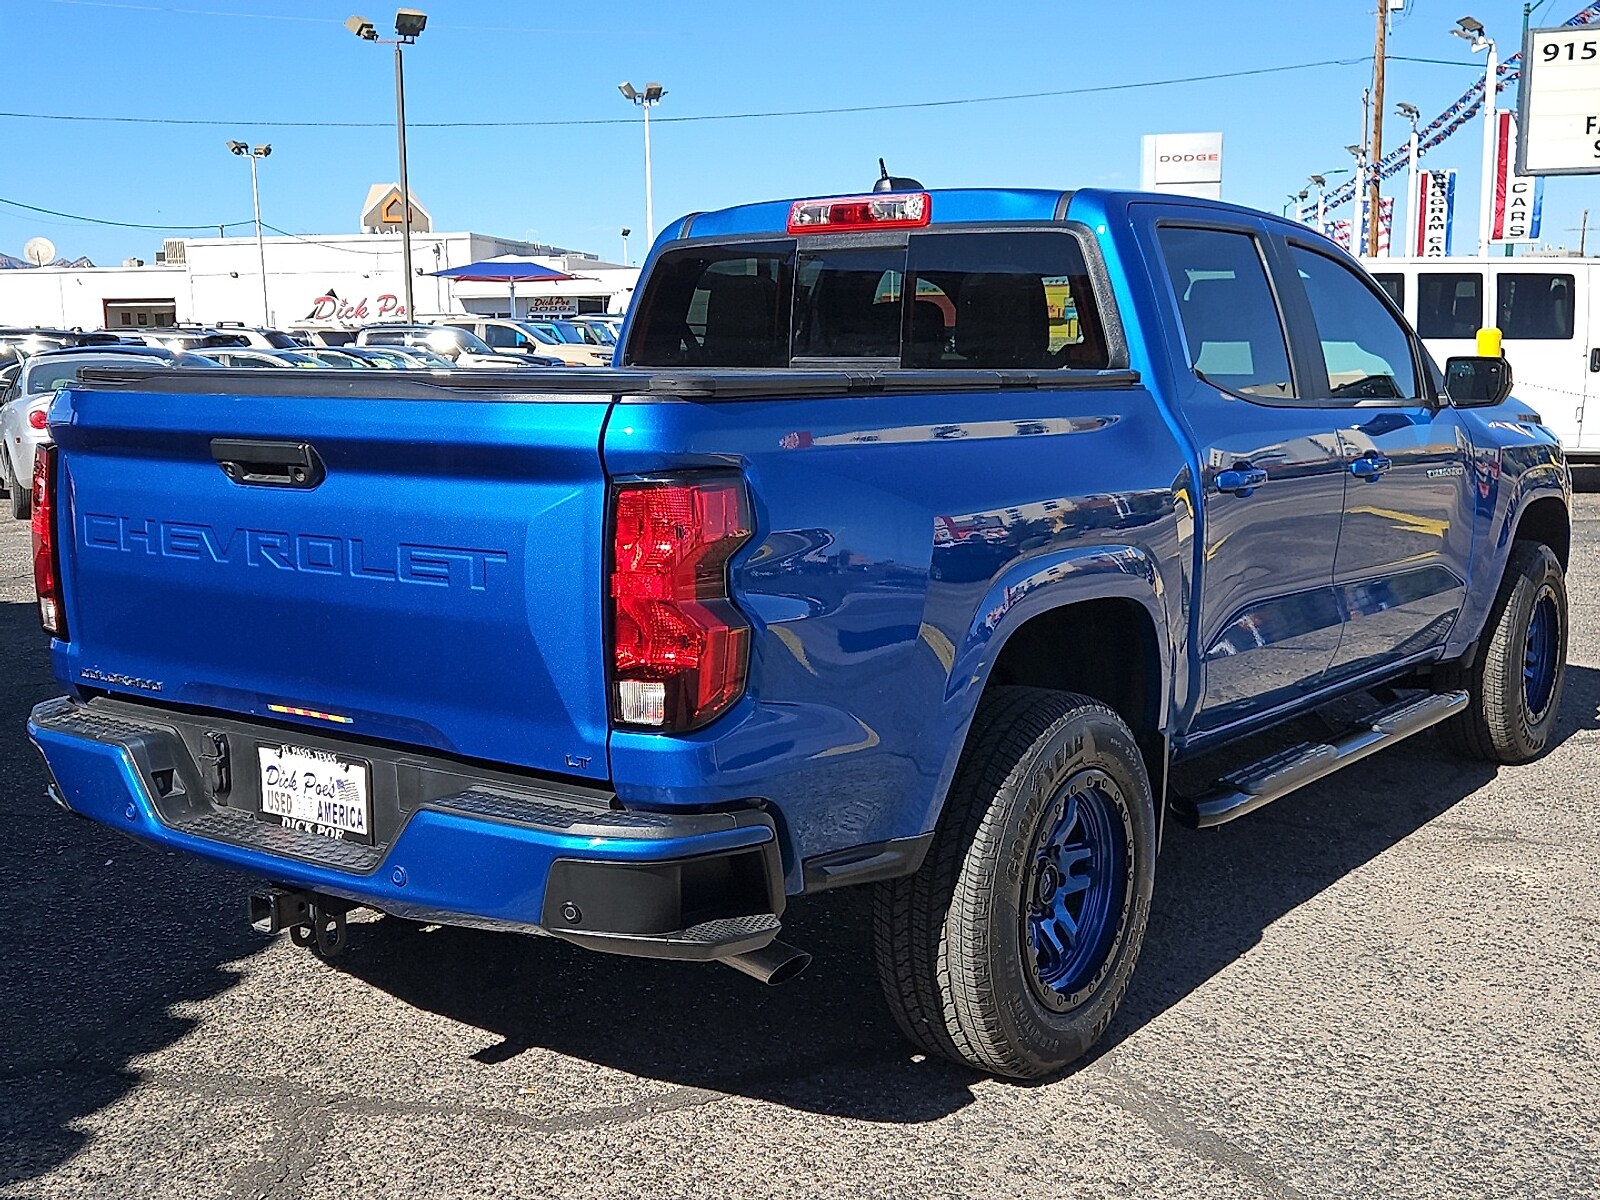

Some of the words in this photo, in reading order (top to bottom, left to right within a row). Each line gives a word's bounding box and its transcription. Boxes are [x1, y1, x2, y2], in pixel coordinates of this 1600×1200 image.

[1542, 41, 1598, 62] 915
[1585, 115, 1600, 135] F
[1159, 153, 1219, 163] DODGE
[1509, 182, 1529, 238] CARS
[313, 296, 370, 321] Dick
[376, 293, 417, 318] Po
[534, 297, 554, 307] Dick
[83, 512, 508, 592] CHEVROLET
[565, 754, 593, 770] LT
[265, 764, 298, 791] Dick
[303, 772, 336, 798] Poe's
[267, 790, 293, 815] USED
[317, 800, 364, 830] AMERICA
[281, 815, 316, 834] DICK
